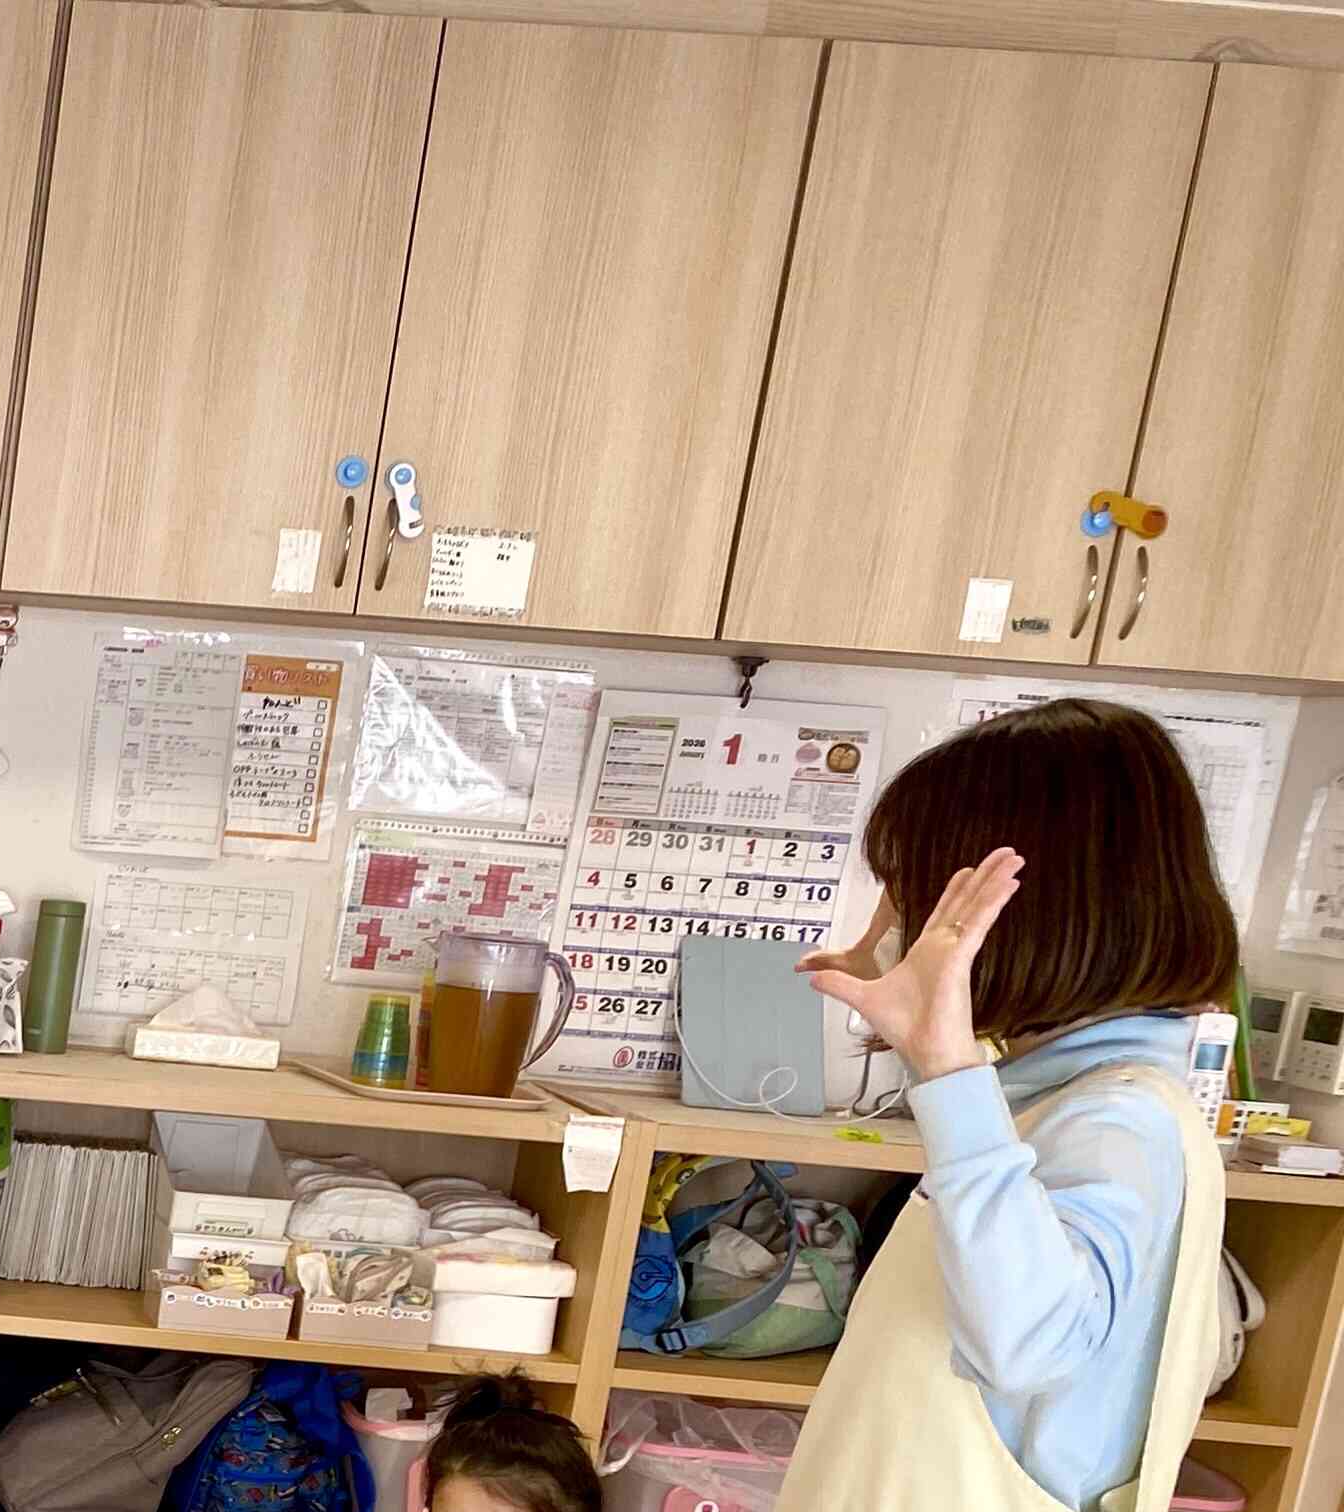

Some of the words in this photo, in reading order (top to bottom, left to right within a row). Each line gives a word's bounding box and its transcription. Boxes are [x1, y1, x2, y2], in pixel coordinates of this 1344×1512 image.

[722, 734, 742, 765] 1
[590, 828, 616, 845] 28
[625, 831, 653, 847] 29
[662, 833, 689, 849] 30
[698, 836, 726, 852] 31
[746, 839, 757, 854] 1
[783, 842, 798, 857] 2
[821, 845, 835, 860] 3
[587, 871, 601, 886] 4
[624, 873, 637, 888] 5
[661, 876, 673, 891] 6
[699, 878, 713, 893] 7
[735, 881, 749, 896] 8
[773, 884, 787, 899] 9
[805, 886, 831, 901] 10
[574, 912, 598, 928] 11
[611, 915, 637, 930] 12
[648, 917, 673, 933] 13
[685, 920, 710, 935] 14
[723, 923, 747, 938] 15
[759, 925, 785, 940] 16
[797, 927, 823, 943] 17
[568, 954, 593, 968] 18
[606, 956, 630, 972] 19
[641, 959, 667, 974] 20
[574, 996, 587, 1010] 5
[598, 997, 625, 1013] 26
[636, 1000, 663, 1016] 27
